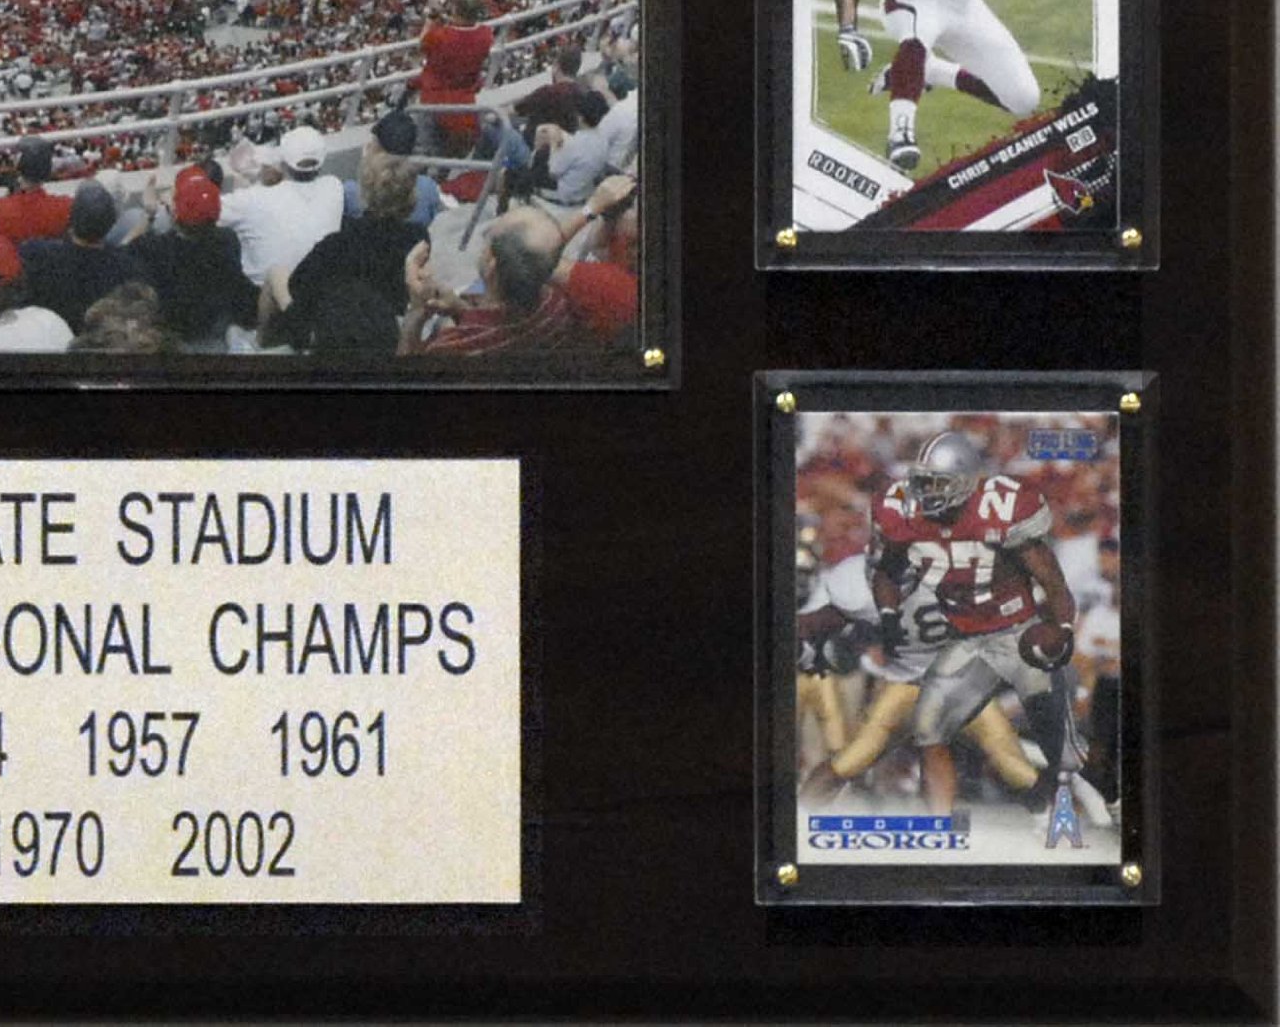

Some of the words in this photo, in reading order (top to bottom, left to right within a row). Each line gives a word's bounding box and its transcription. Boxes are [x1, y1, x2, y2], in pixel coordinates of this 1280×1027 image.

[948, 160, 991, 190] CHRIS
[1053, 101, 1100, 133] WELLS
[1068, 129, 1095, 150] RB
[809, 151, 879, 199] ROOKIE
[116, 491, 392, 567] STADIUM
[906, 540, 996, 605] 27
[208, 601, 476, 676] CHAMPS
[78, 711, 201, 778] 1957
[270, 710, 387, 778] 1961
[170, 810, 296, 878] 2002
[807, 832, 970, 851] GEORGE
[810, 819, 945, 831] EDDIE
